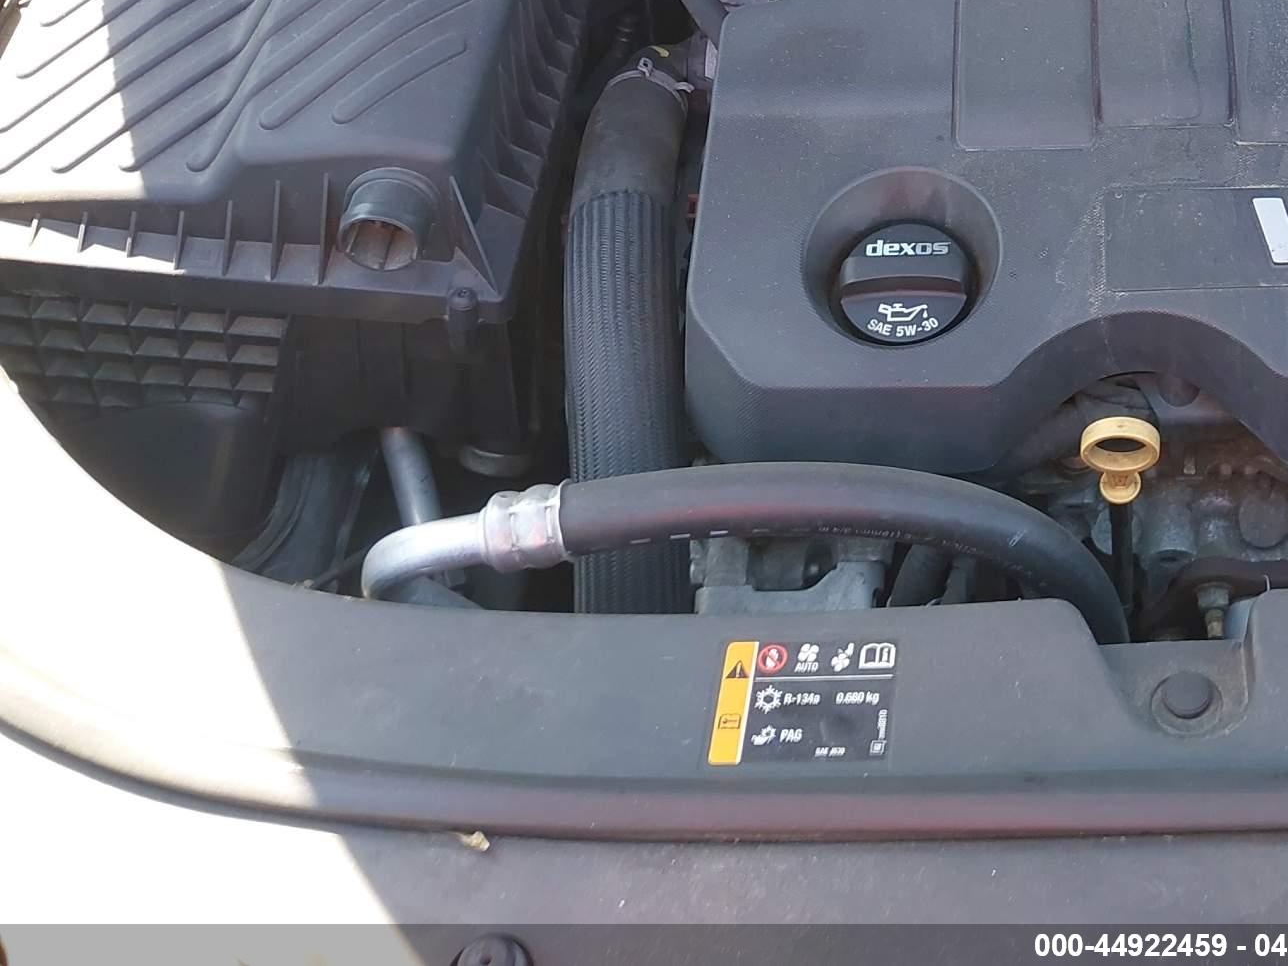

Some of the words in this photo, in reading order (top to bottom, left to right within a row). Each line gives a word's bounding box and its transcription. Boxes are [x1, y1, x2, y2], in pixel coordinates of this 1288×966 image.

[865, 239, 951, 257] dexos
[867, 318, 893, 336] SAE
[896, 317, 939, 337] 5W-30
[794, 661, 819, 673] AUTO
[865, 691, 880, 706] kg
[779, 728, 803, 743] PAG
